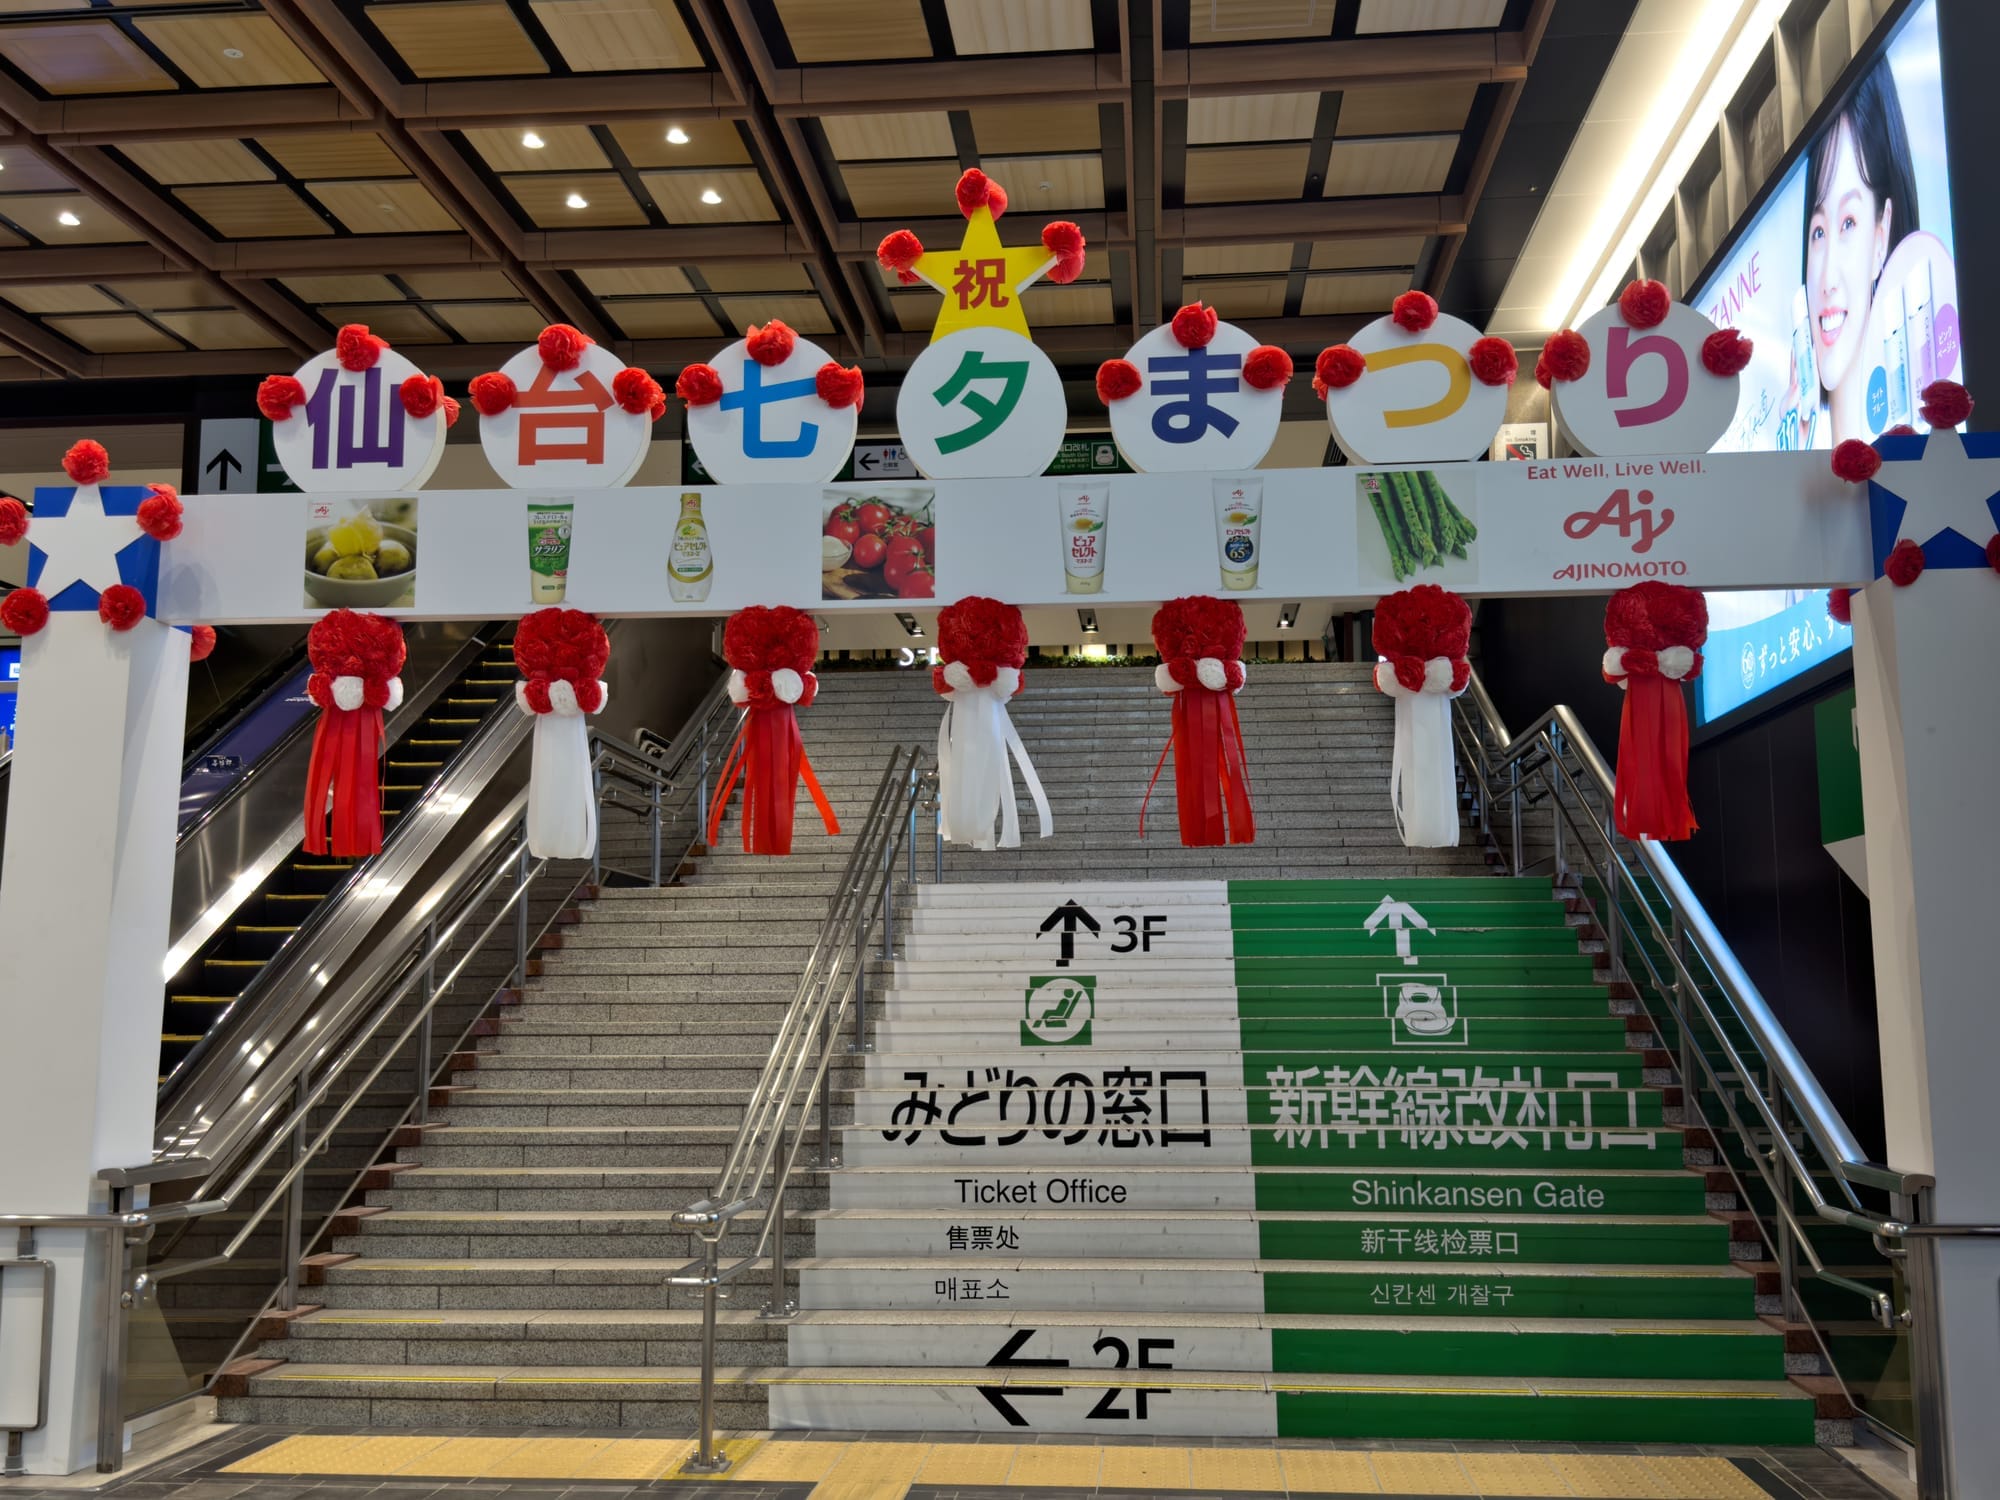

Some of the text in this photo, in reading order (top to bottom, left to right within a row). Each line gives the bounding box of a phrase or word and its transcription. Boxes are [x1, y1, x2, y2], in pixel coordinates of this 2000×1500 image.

[953, 258, 1009, 310] 祝
[306, 327, 1689, 469] 仙台七夕まつり
[1528, 459, 1706, 480] Eat Well, Live Well.
[534, 545, 566, 555] サラリア
[674, 541, 708, 551] ピュアセレクト
[1072, 547, 1098, 558] セレクト
[1073, 536, 1096, 547] ピュア
[1553, 561, 1687, 581] AJINOMOTO
[1110, 915, 1167, 953] 3F
[882, 1066, 1211, 1147] みどりの窓口
[1266, 1065, 1656, 1151] 新幹線改札口
[954, 1178, 1127, 1203] Ticket Office
[1352, 1179, 1605, 1208] Shinkansen Gate
[946, 1225, 1020, 1250] 售票处
[1361, 1228, 1519, 1255] 新干线检票口
[935, 1277, 1010, 1301] 매표소
[1370, 1283, 1515, 1306] 신칸센 개찰구
[1085, 1336, 1175, 1420] 2F
